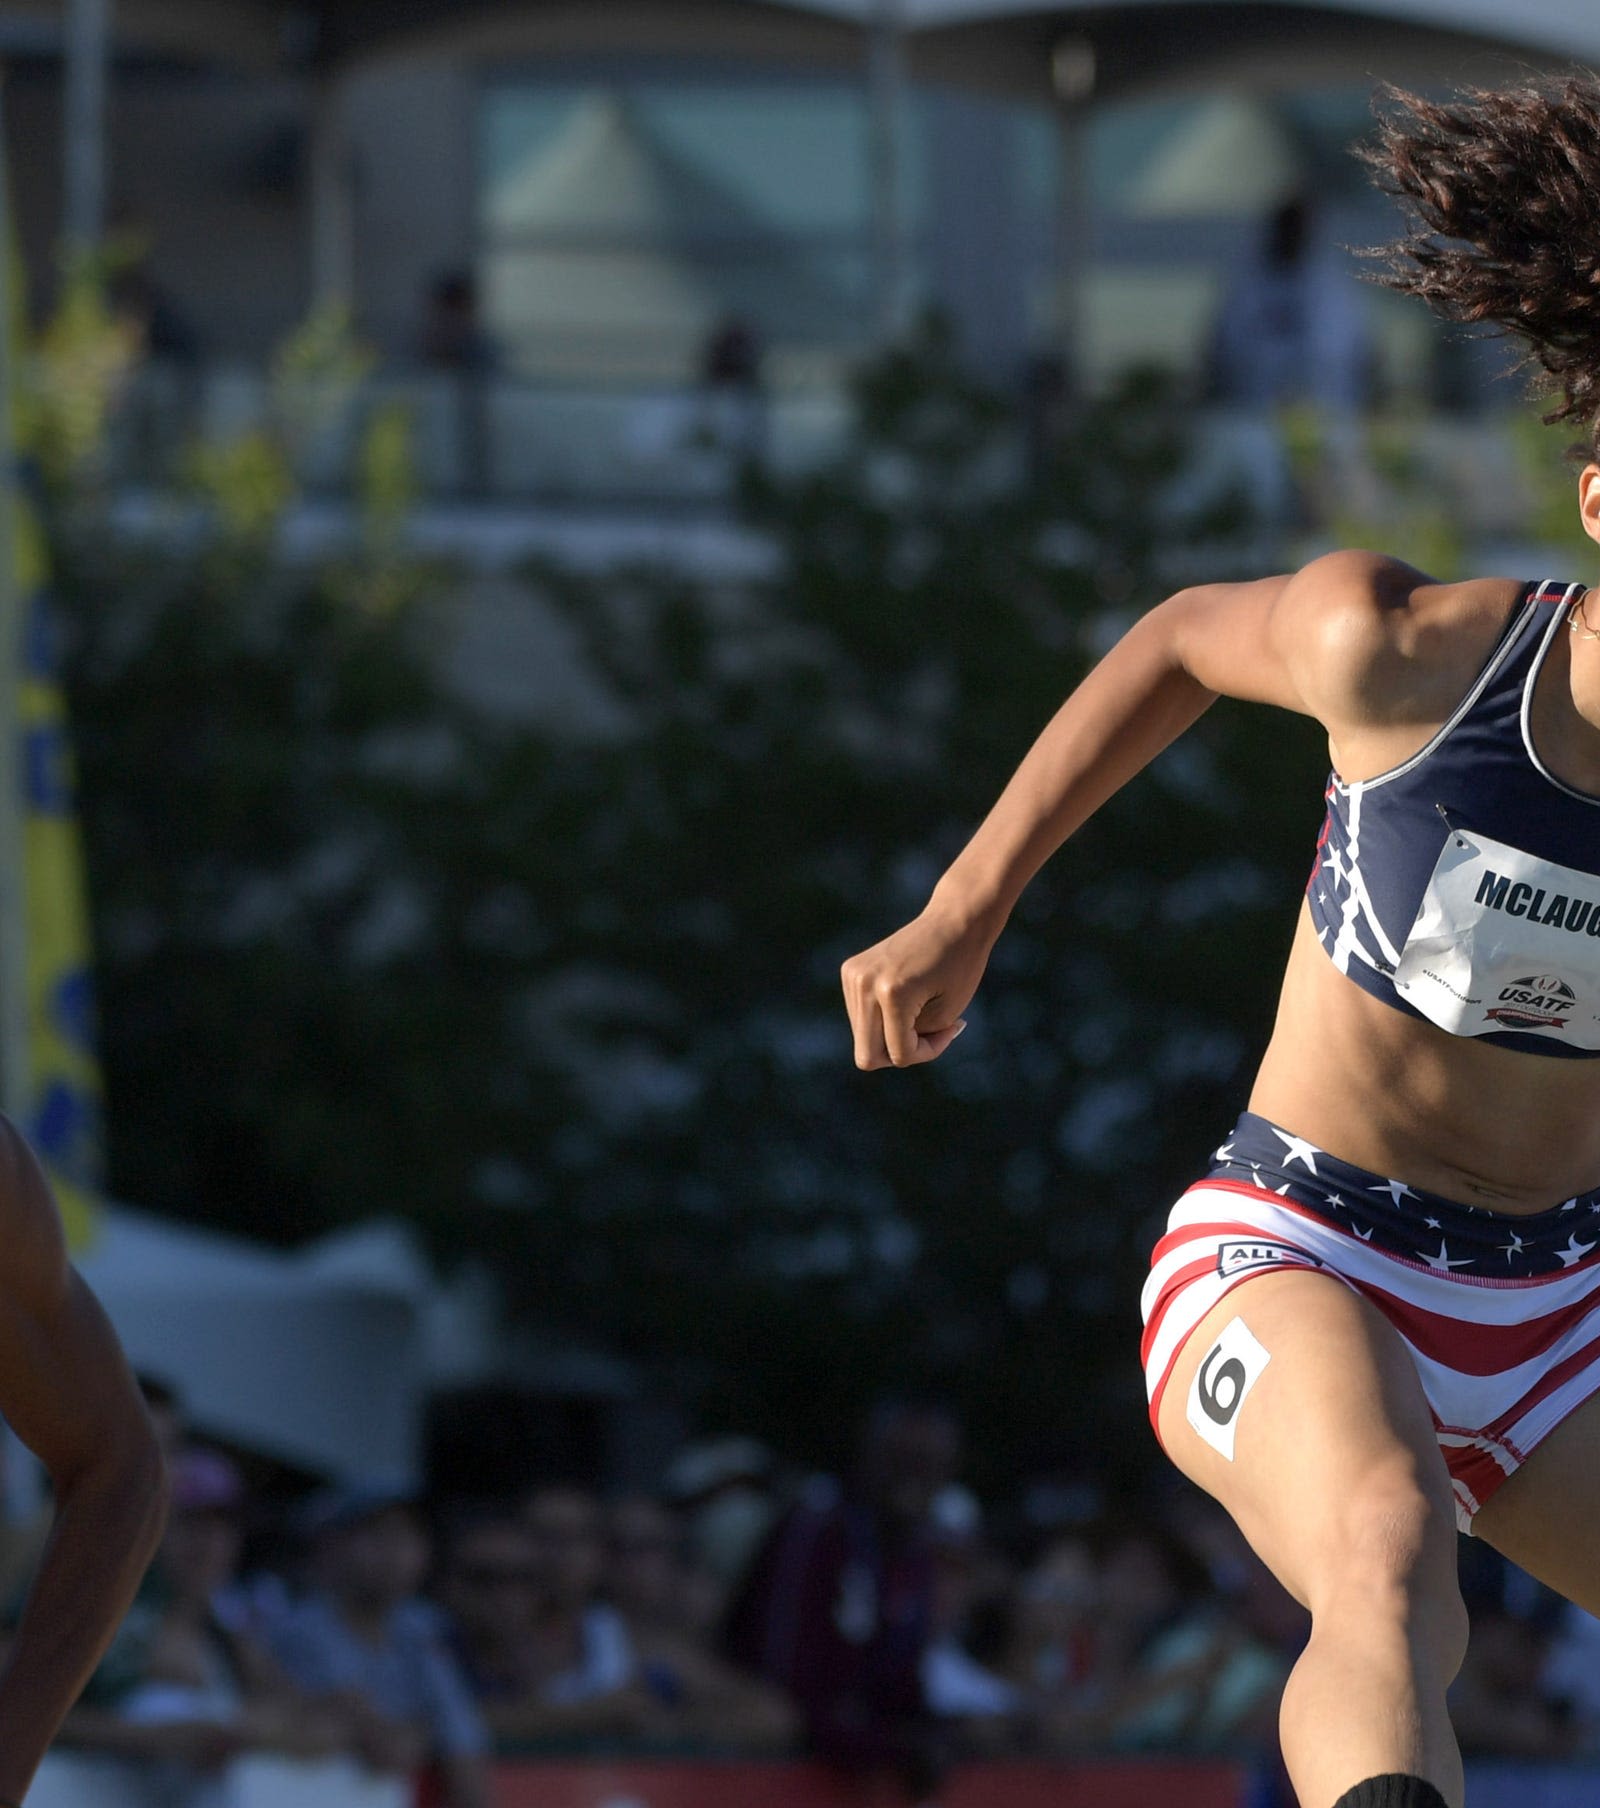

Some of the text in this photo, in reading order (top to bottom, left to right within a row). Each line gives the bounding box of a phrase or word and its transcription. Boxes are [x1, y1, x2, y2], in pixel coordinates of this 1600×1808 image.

[1499, 988, 1575, 1012] USATF
[1230, 1248, 1279, 1260] ALL
[1198, 1343, 1246, 1426] 6
